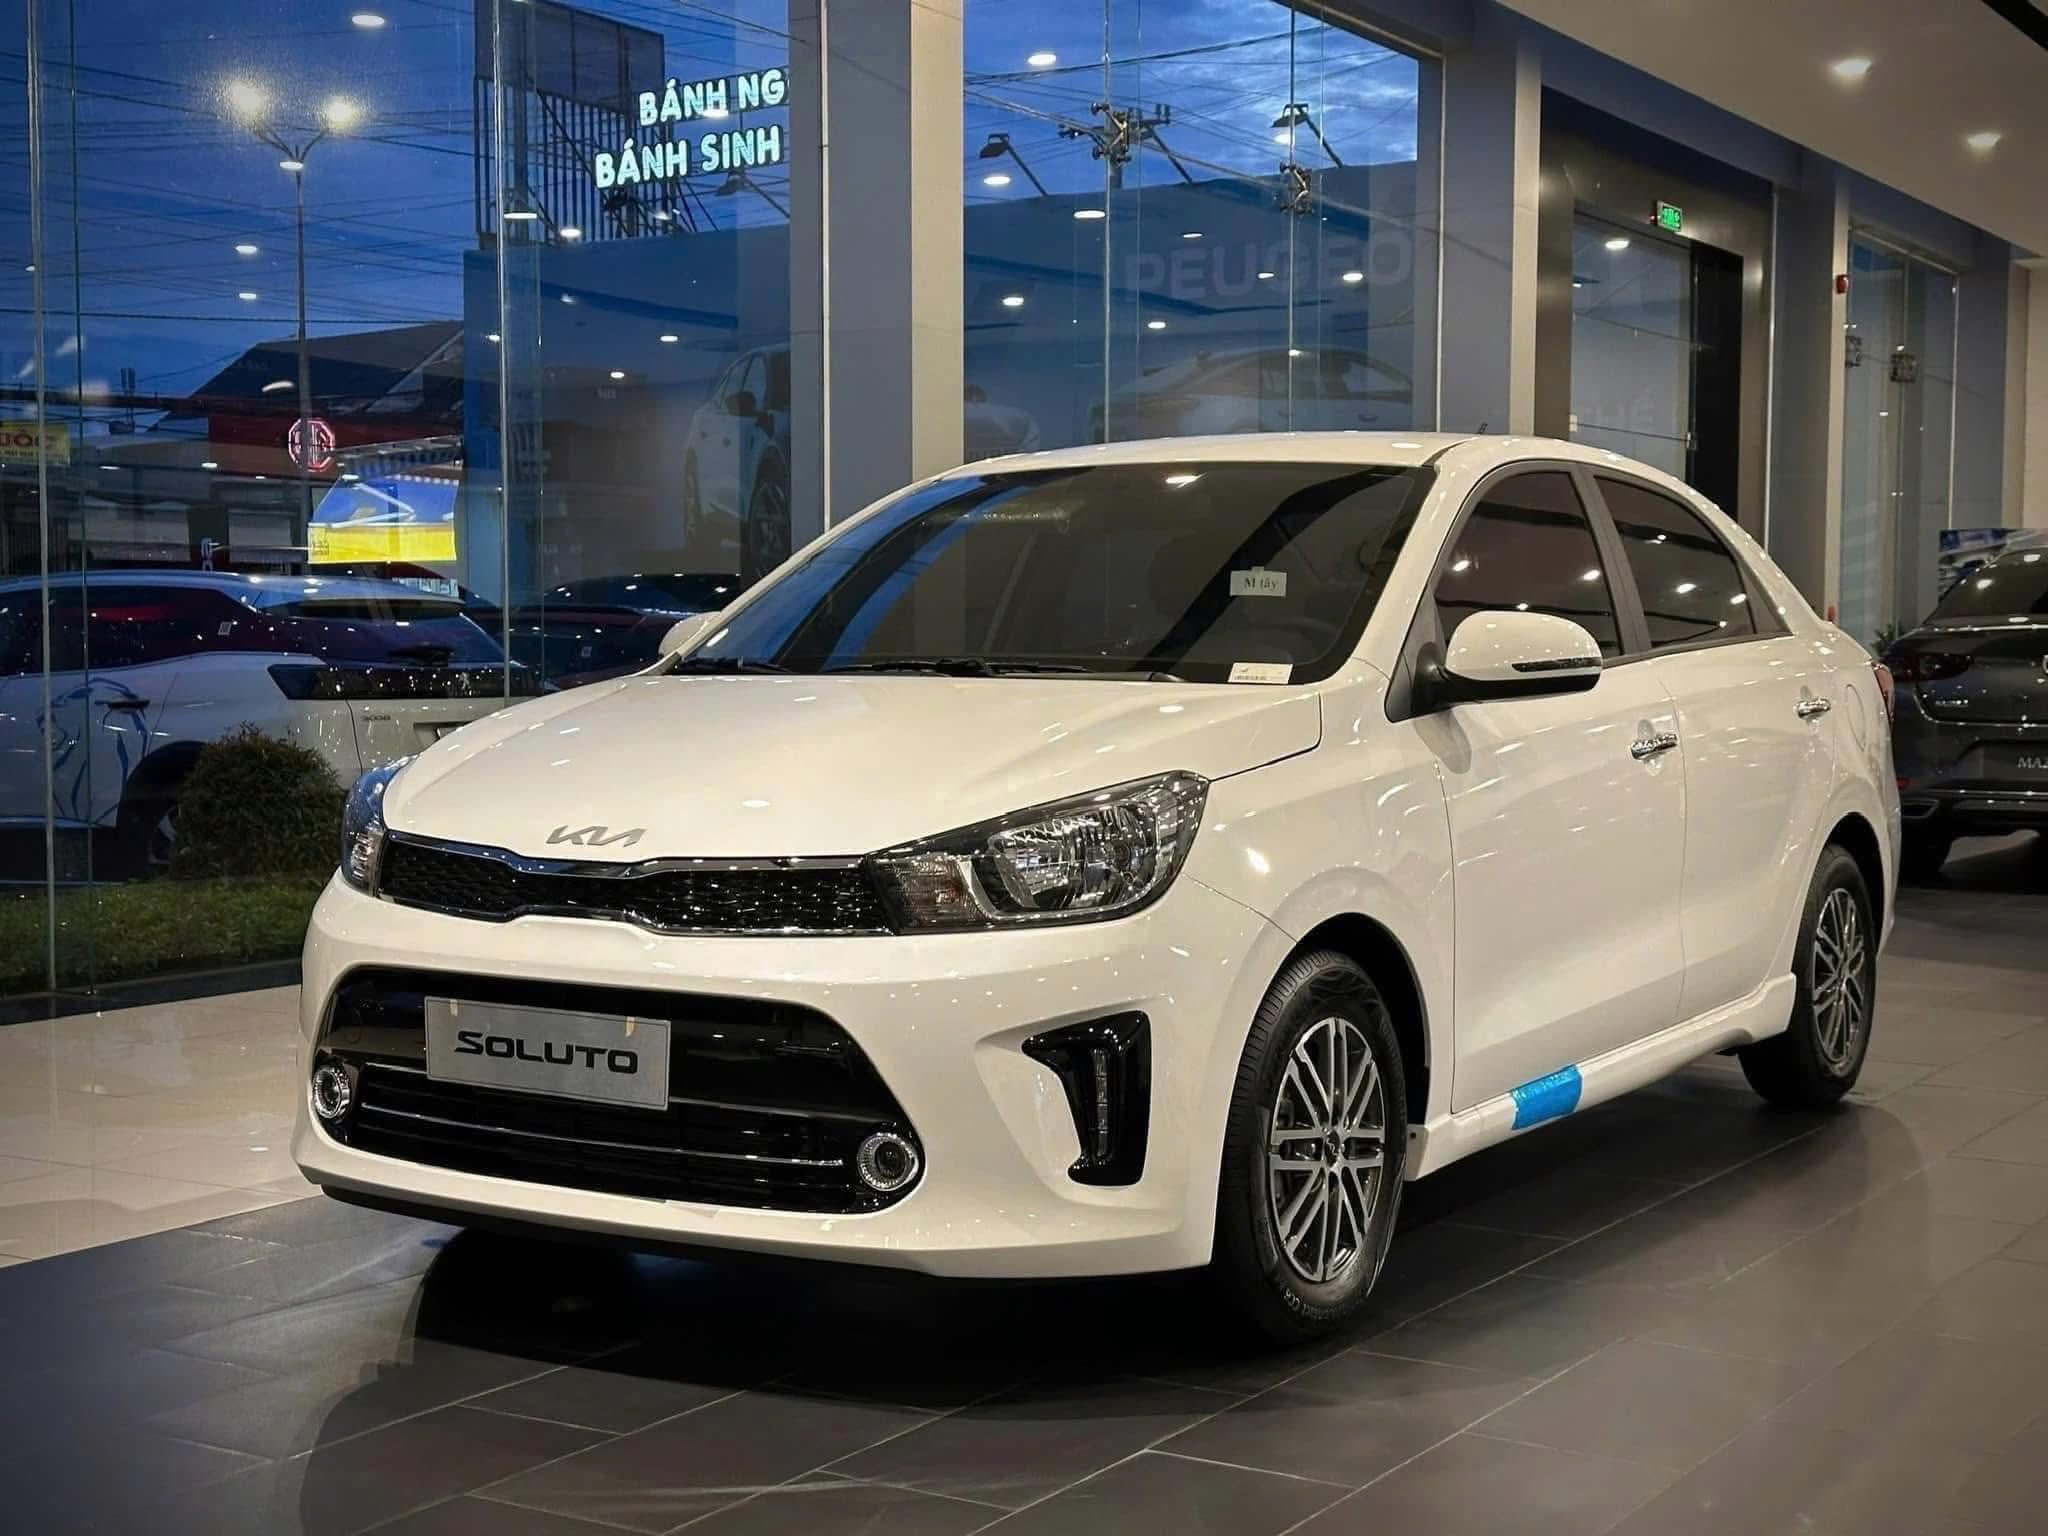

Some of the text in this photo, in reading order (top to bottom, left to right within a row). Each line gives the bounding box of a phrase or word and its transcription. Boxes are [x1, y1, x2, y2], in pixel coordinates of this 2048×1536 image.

[639, 69, 790, 126] BÁNH NG
[595, 125, 780, 188] BÁNH SINH
[546, 824, 648, 848] KIA
[454, 1030, 639, 1075] SOLUTO
